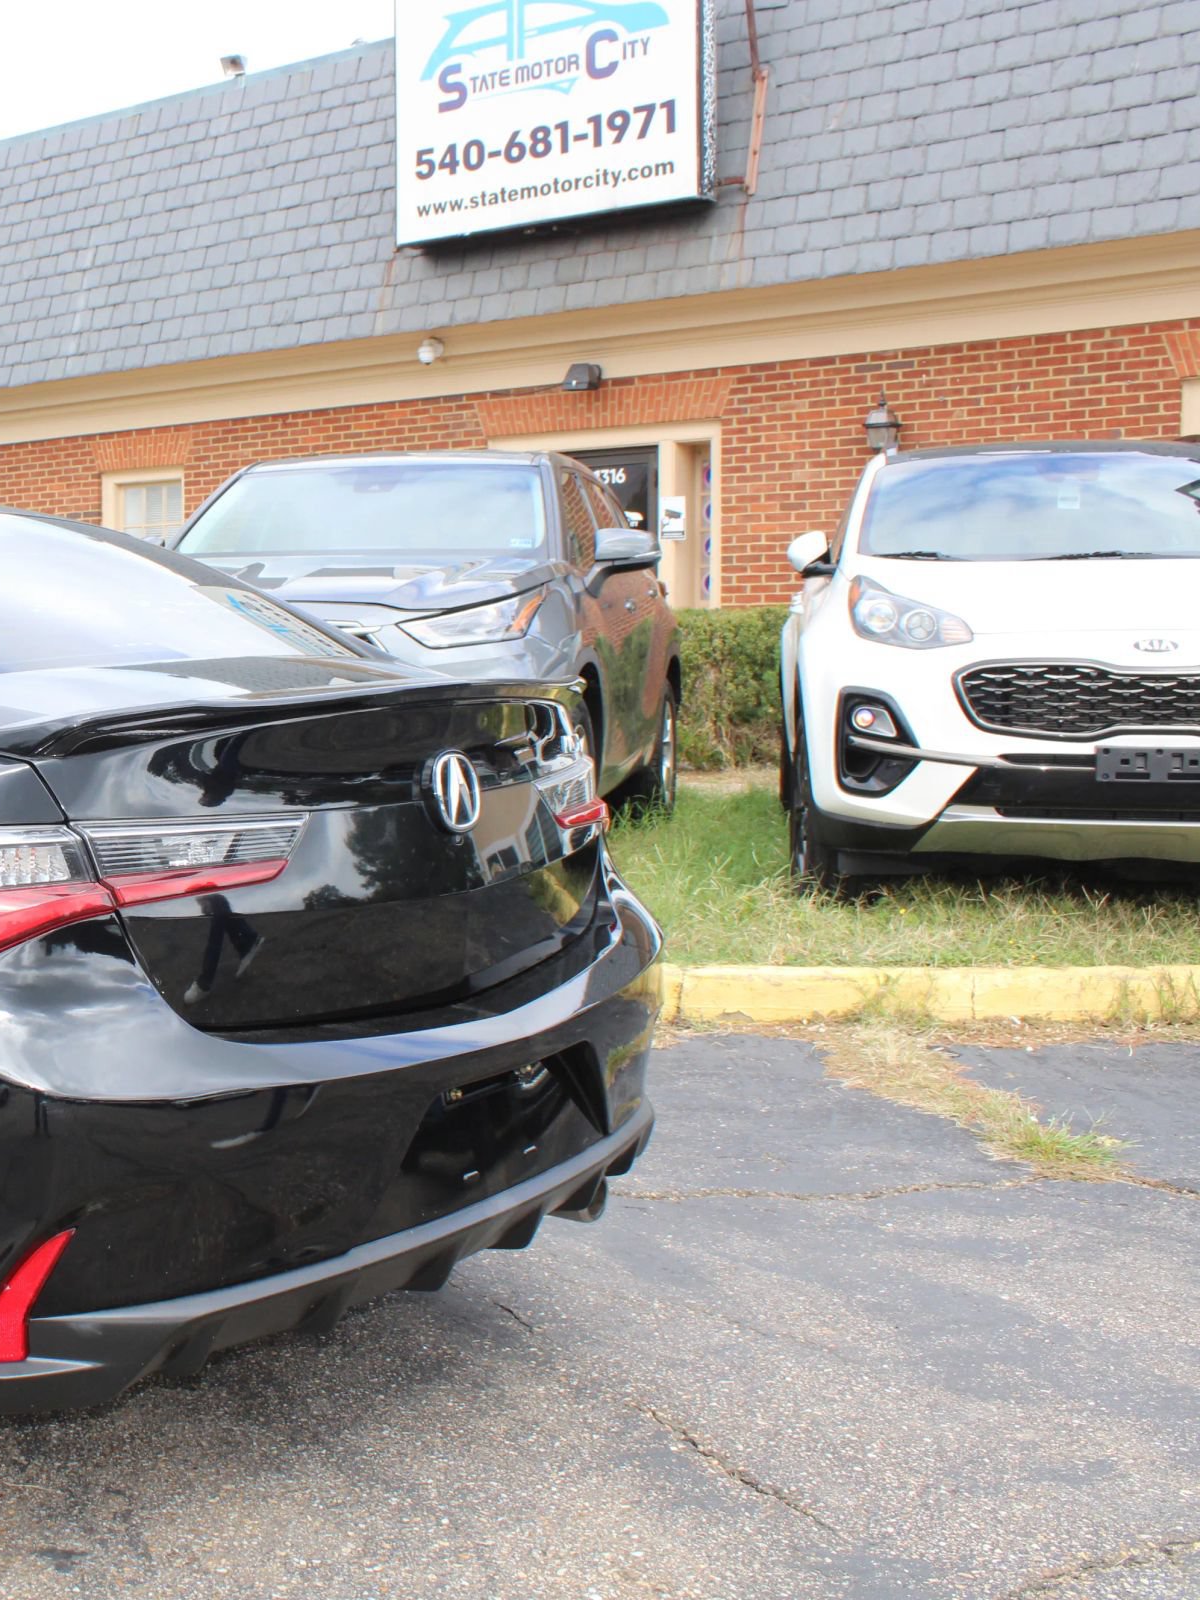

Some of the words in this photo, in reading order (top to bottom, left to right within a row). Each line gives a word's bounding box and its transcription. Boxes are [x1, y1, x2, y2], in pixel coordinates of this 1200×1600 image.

[514, 53, 580, 84] MOTOR
[585, 28, 651, 80] CITY
[414, 98, 676, 181] 540-681-1971
[416, 160, 675, 217] www.statemotorcity.com
